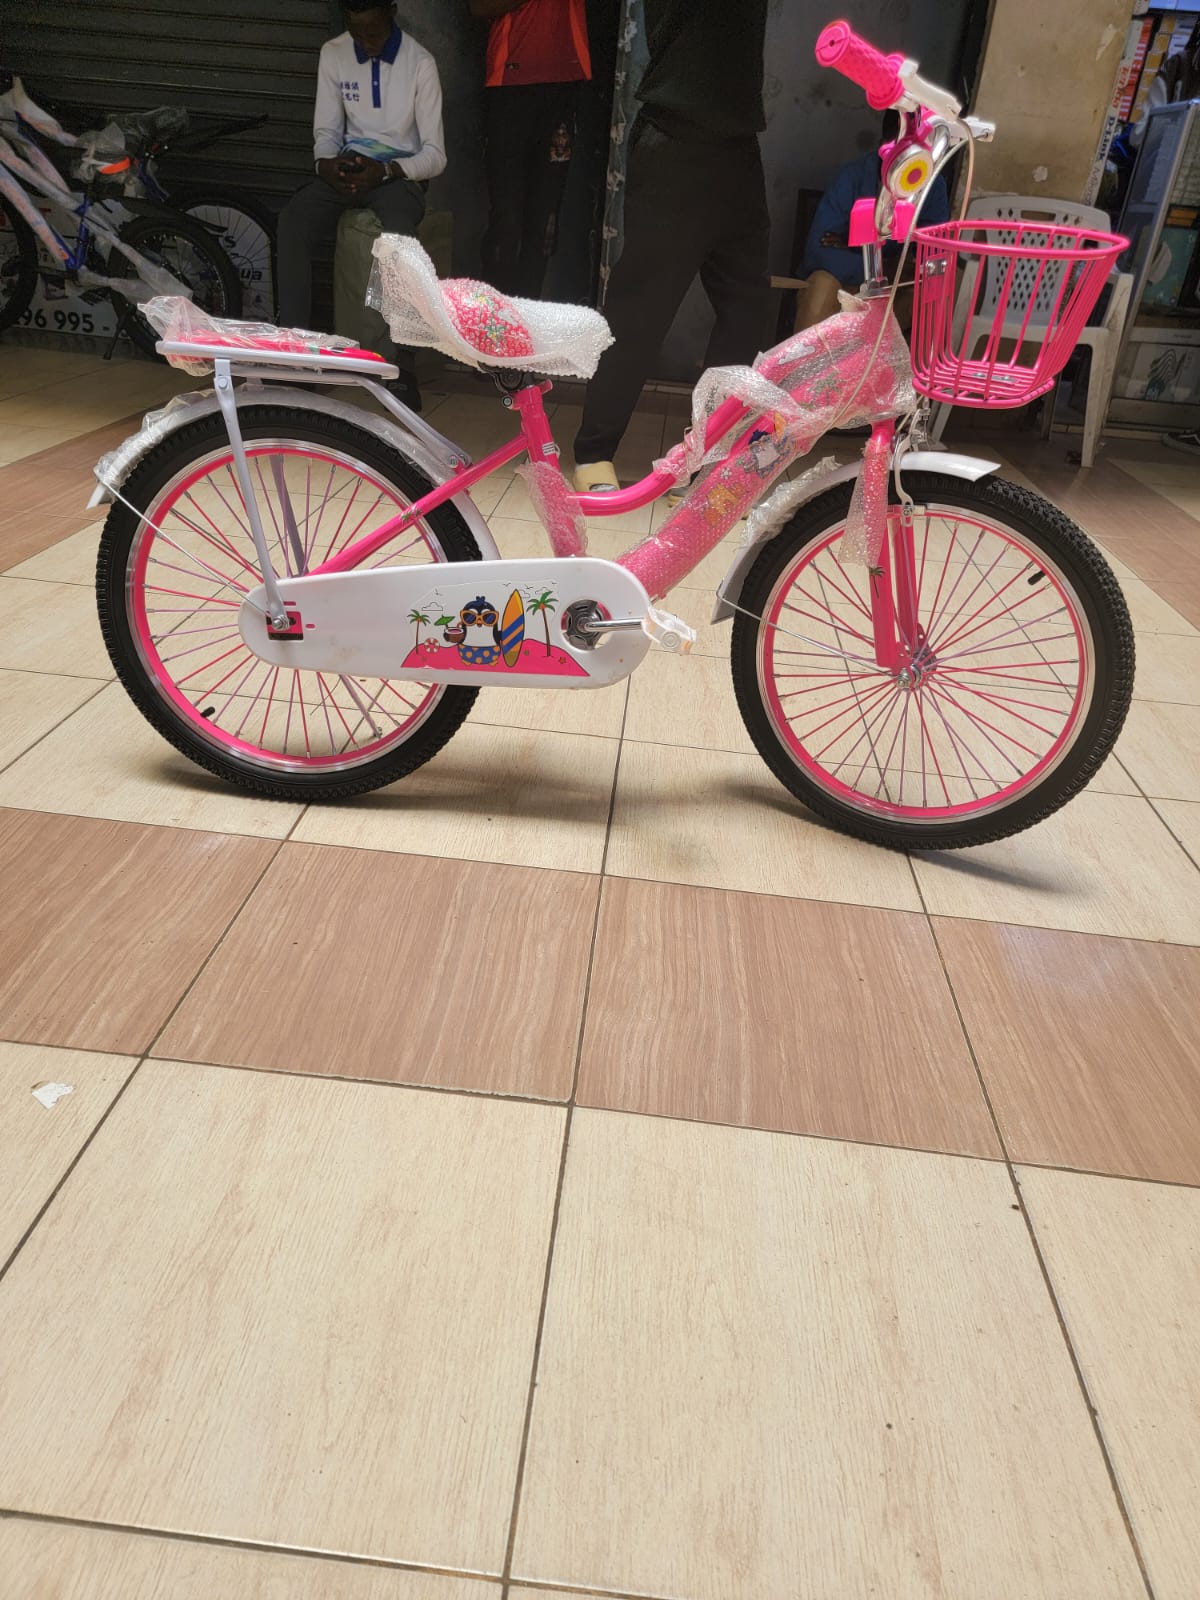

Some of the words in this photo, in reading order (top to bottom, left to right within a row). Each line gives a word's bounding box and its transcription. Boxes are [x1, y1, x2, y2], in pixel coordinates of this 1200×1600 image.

[1097, 116, 1116, 160] D-Link
[17, 307, 47, 328] 96
[54, 309, 95, 333] 995
